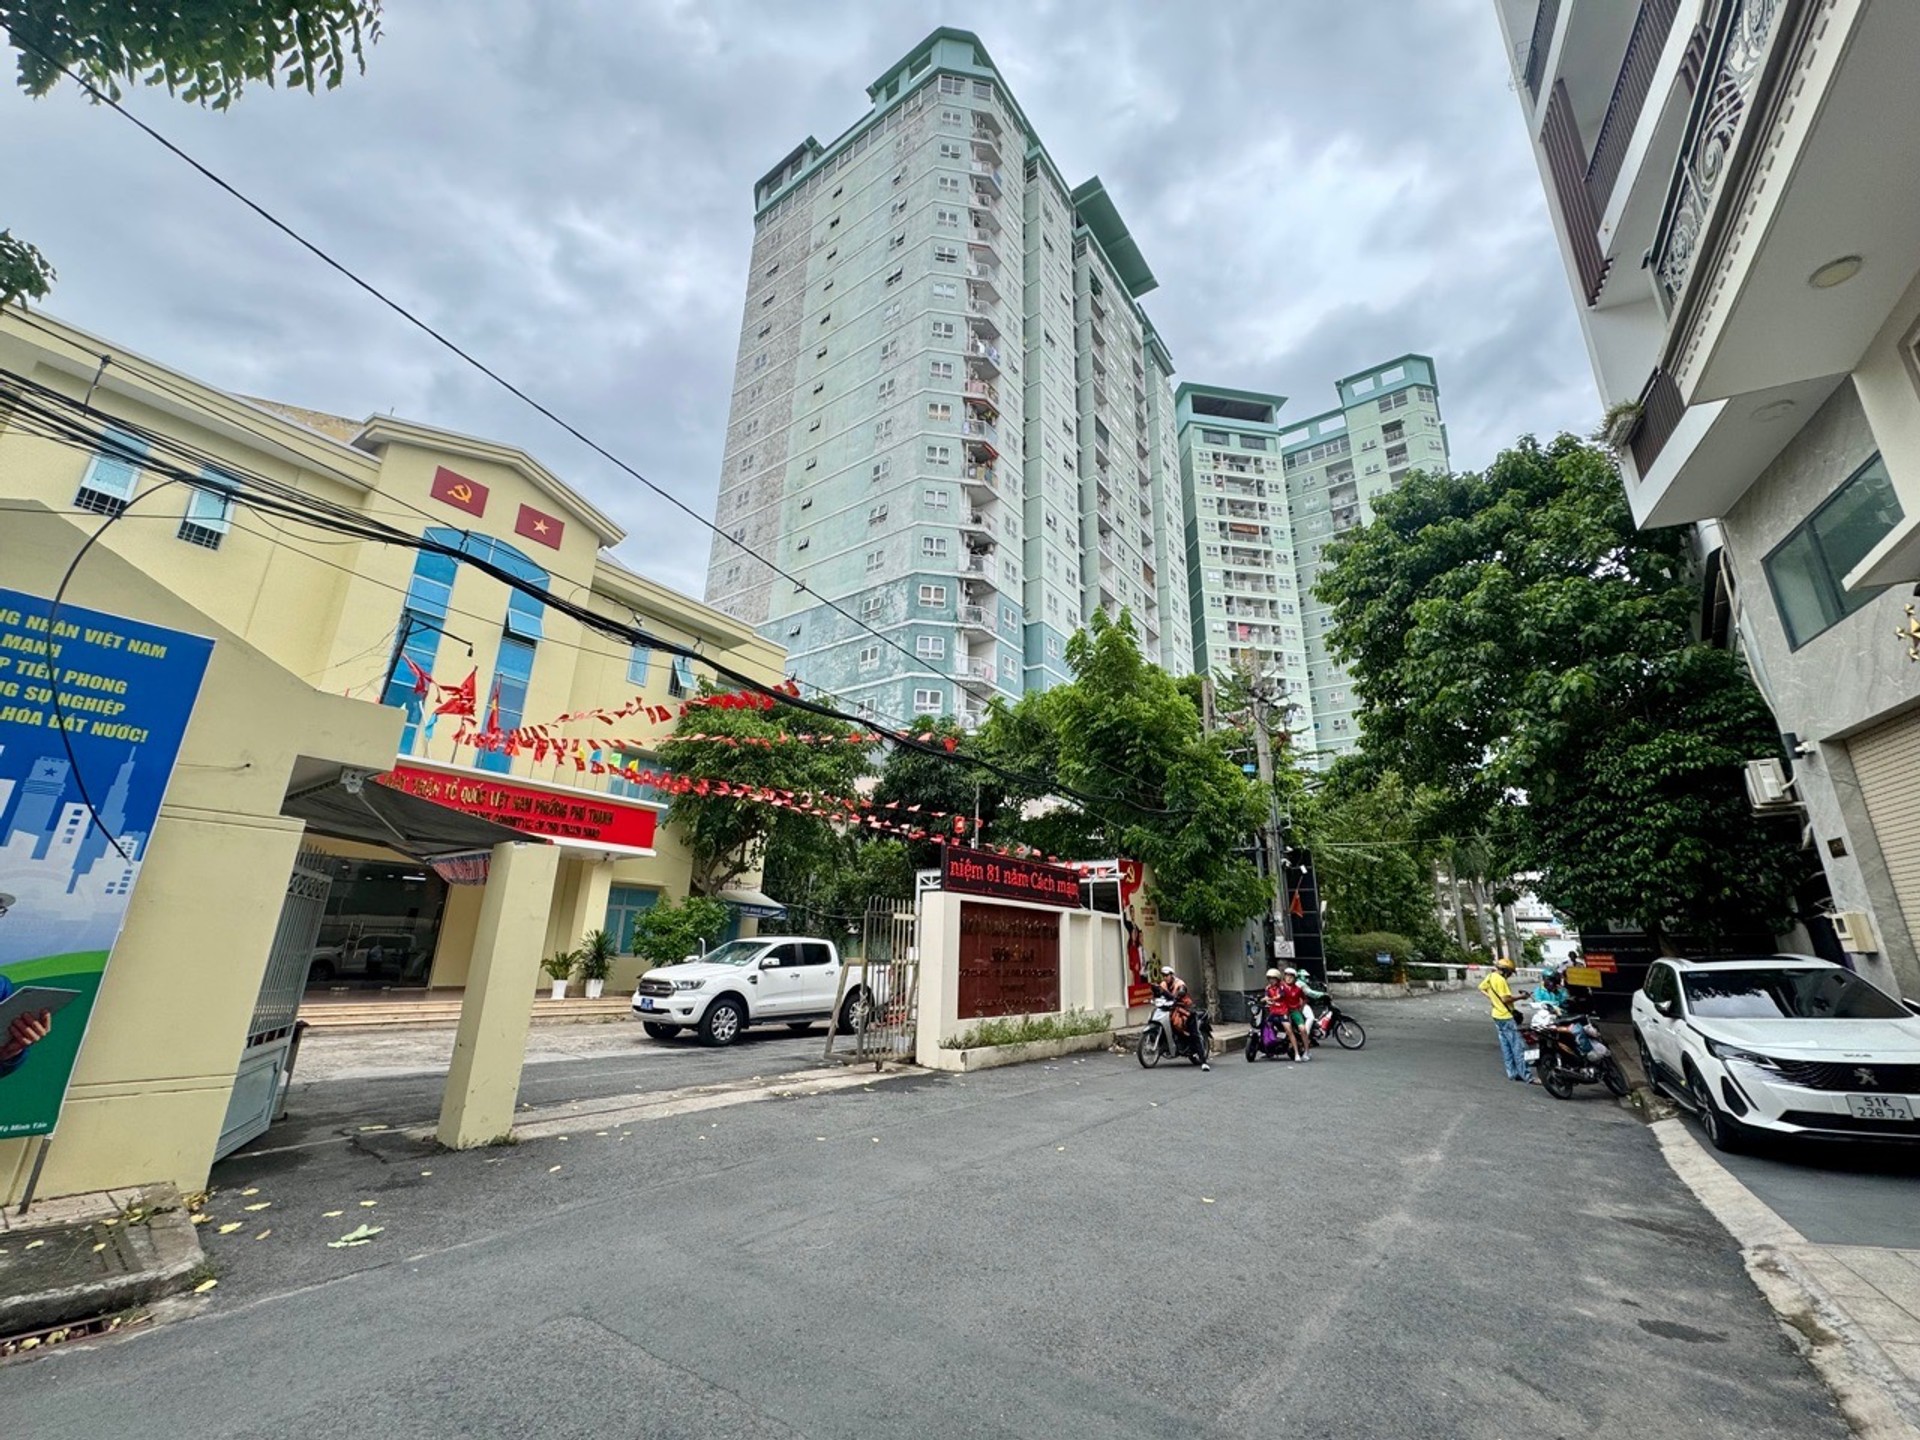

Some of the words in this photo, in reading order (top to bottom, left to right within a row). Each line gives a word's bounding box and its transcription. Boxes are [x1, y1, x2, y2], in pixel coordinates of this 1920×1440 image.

[1, 633, 62, 658] MẠNH
[25, 615, 80, 639] NHÂN
[84, 628, 125, 649] VIỆT
[127, 639, 168, 659] NAM
[63, 669, 128, 695] PHONG
[24, 685, 54, 706] SỰ
[57, 691, 126, 717] NGHIỆP
[90, 721, 149, 743] NƯỚC!
[444, 777, 460, 800] TỔ
[461, 783, 487, 805] QUỐC
[490, 789, 510, 810] VIỆT
[949, 858, 984, 881] niệm
[986, 864, 1001, 882] 81
[1003, 869, 1028, 887] năm
[1030, 872, 1055, 892] Cách
[1863, 1096, 1892, 1108] 51K
